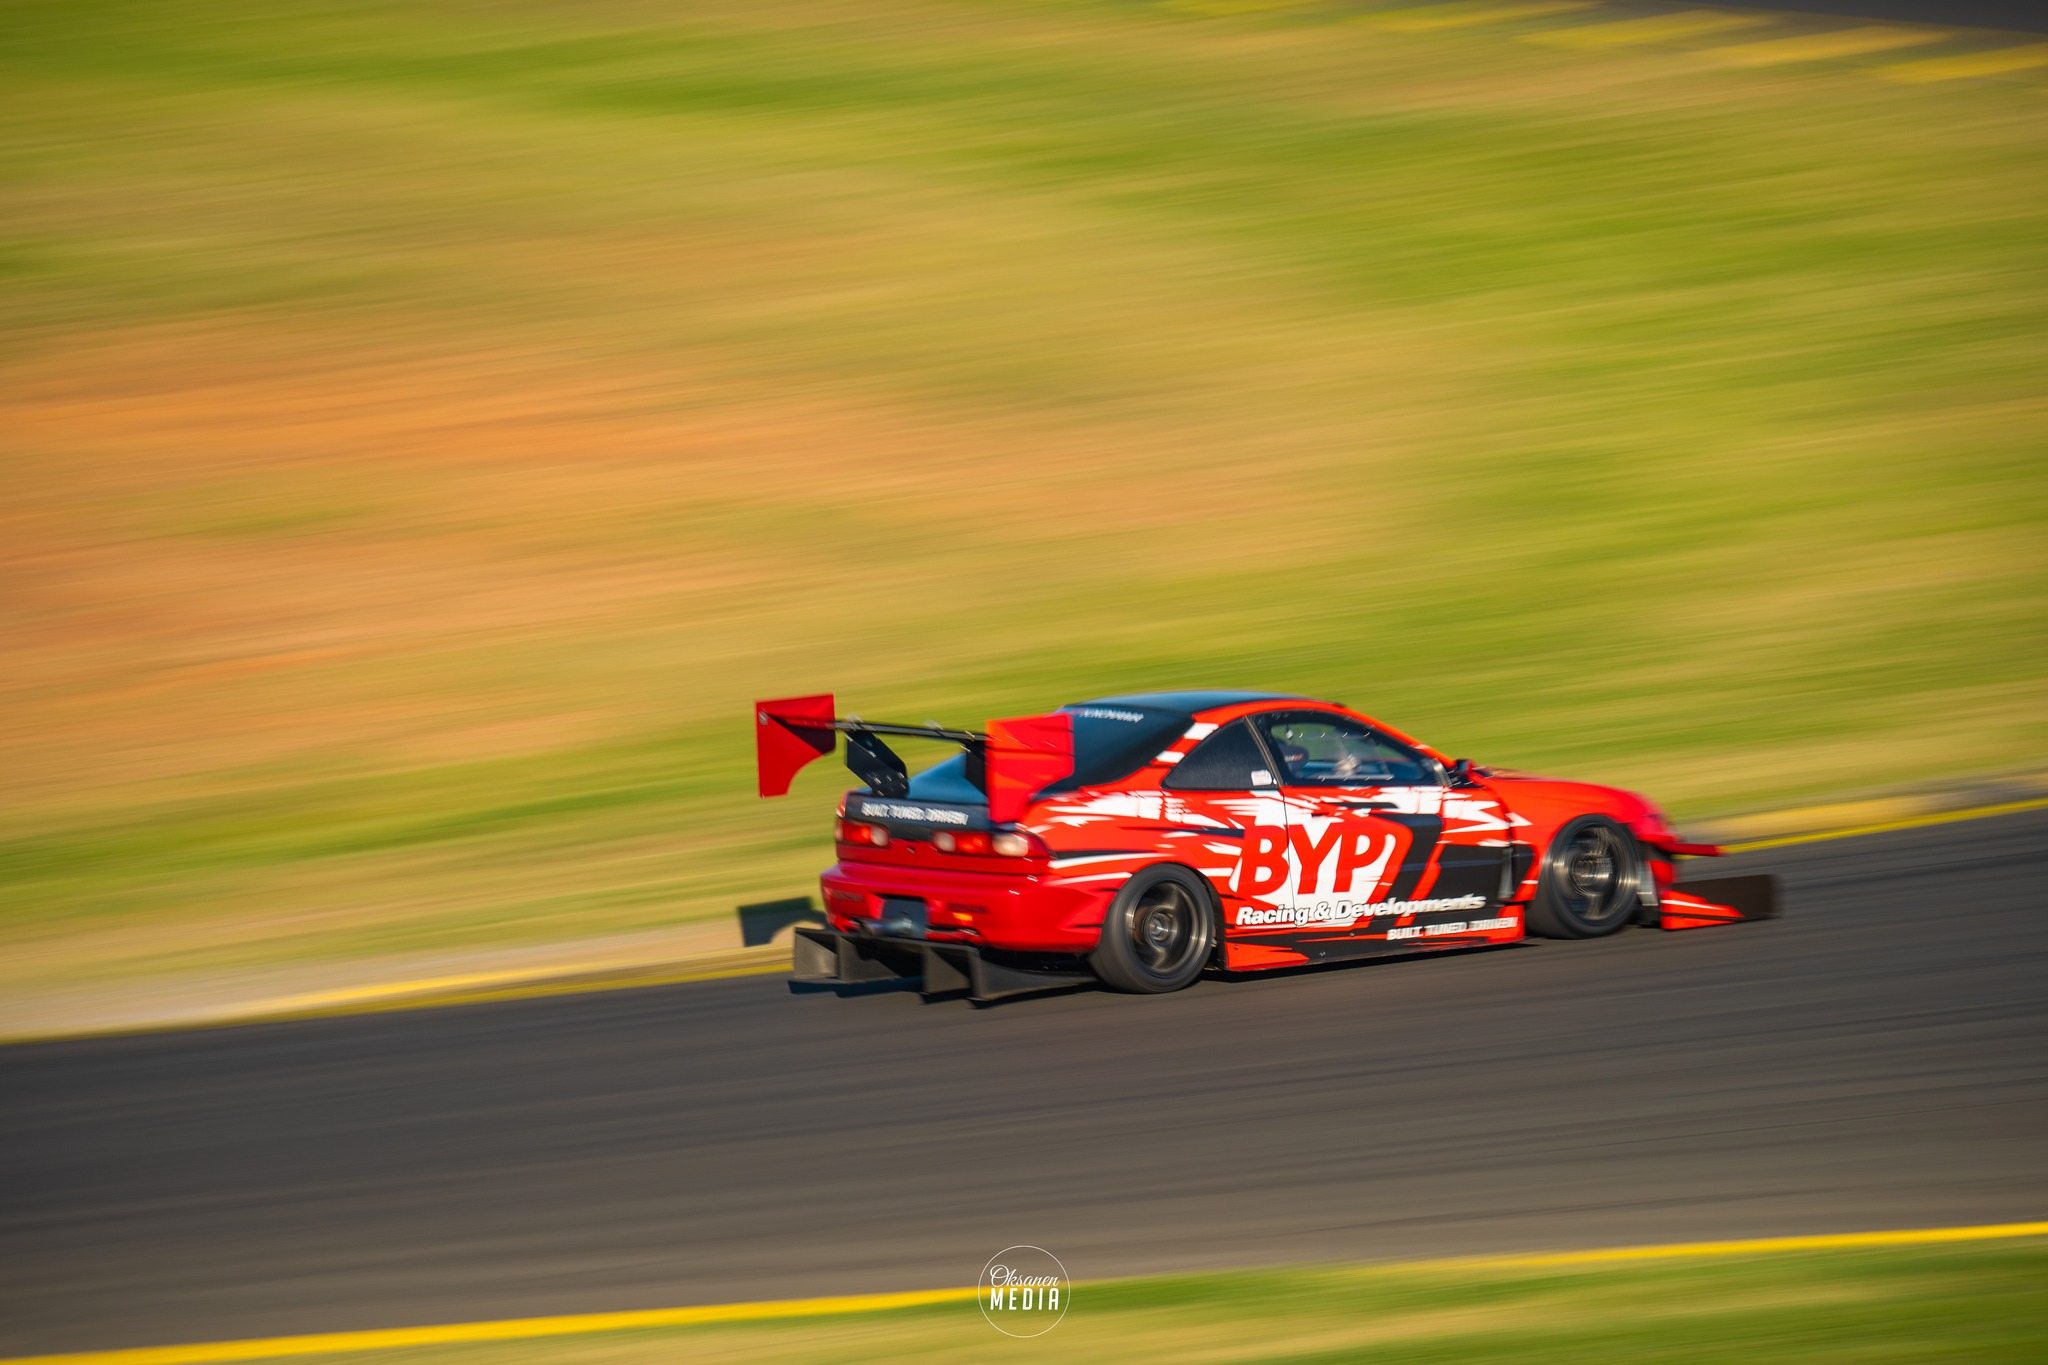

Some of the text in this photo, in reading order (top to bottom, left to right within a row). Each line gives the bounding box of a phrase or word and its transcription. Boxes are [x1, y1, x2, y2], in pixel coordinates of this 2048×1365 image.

[1237, 822, 1387, 896] BYP
[1236, 893, 1487, 927] Racing & Developments
